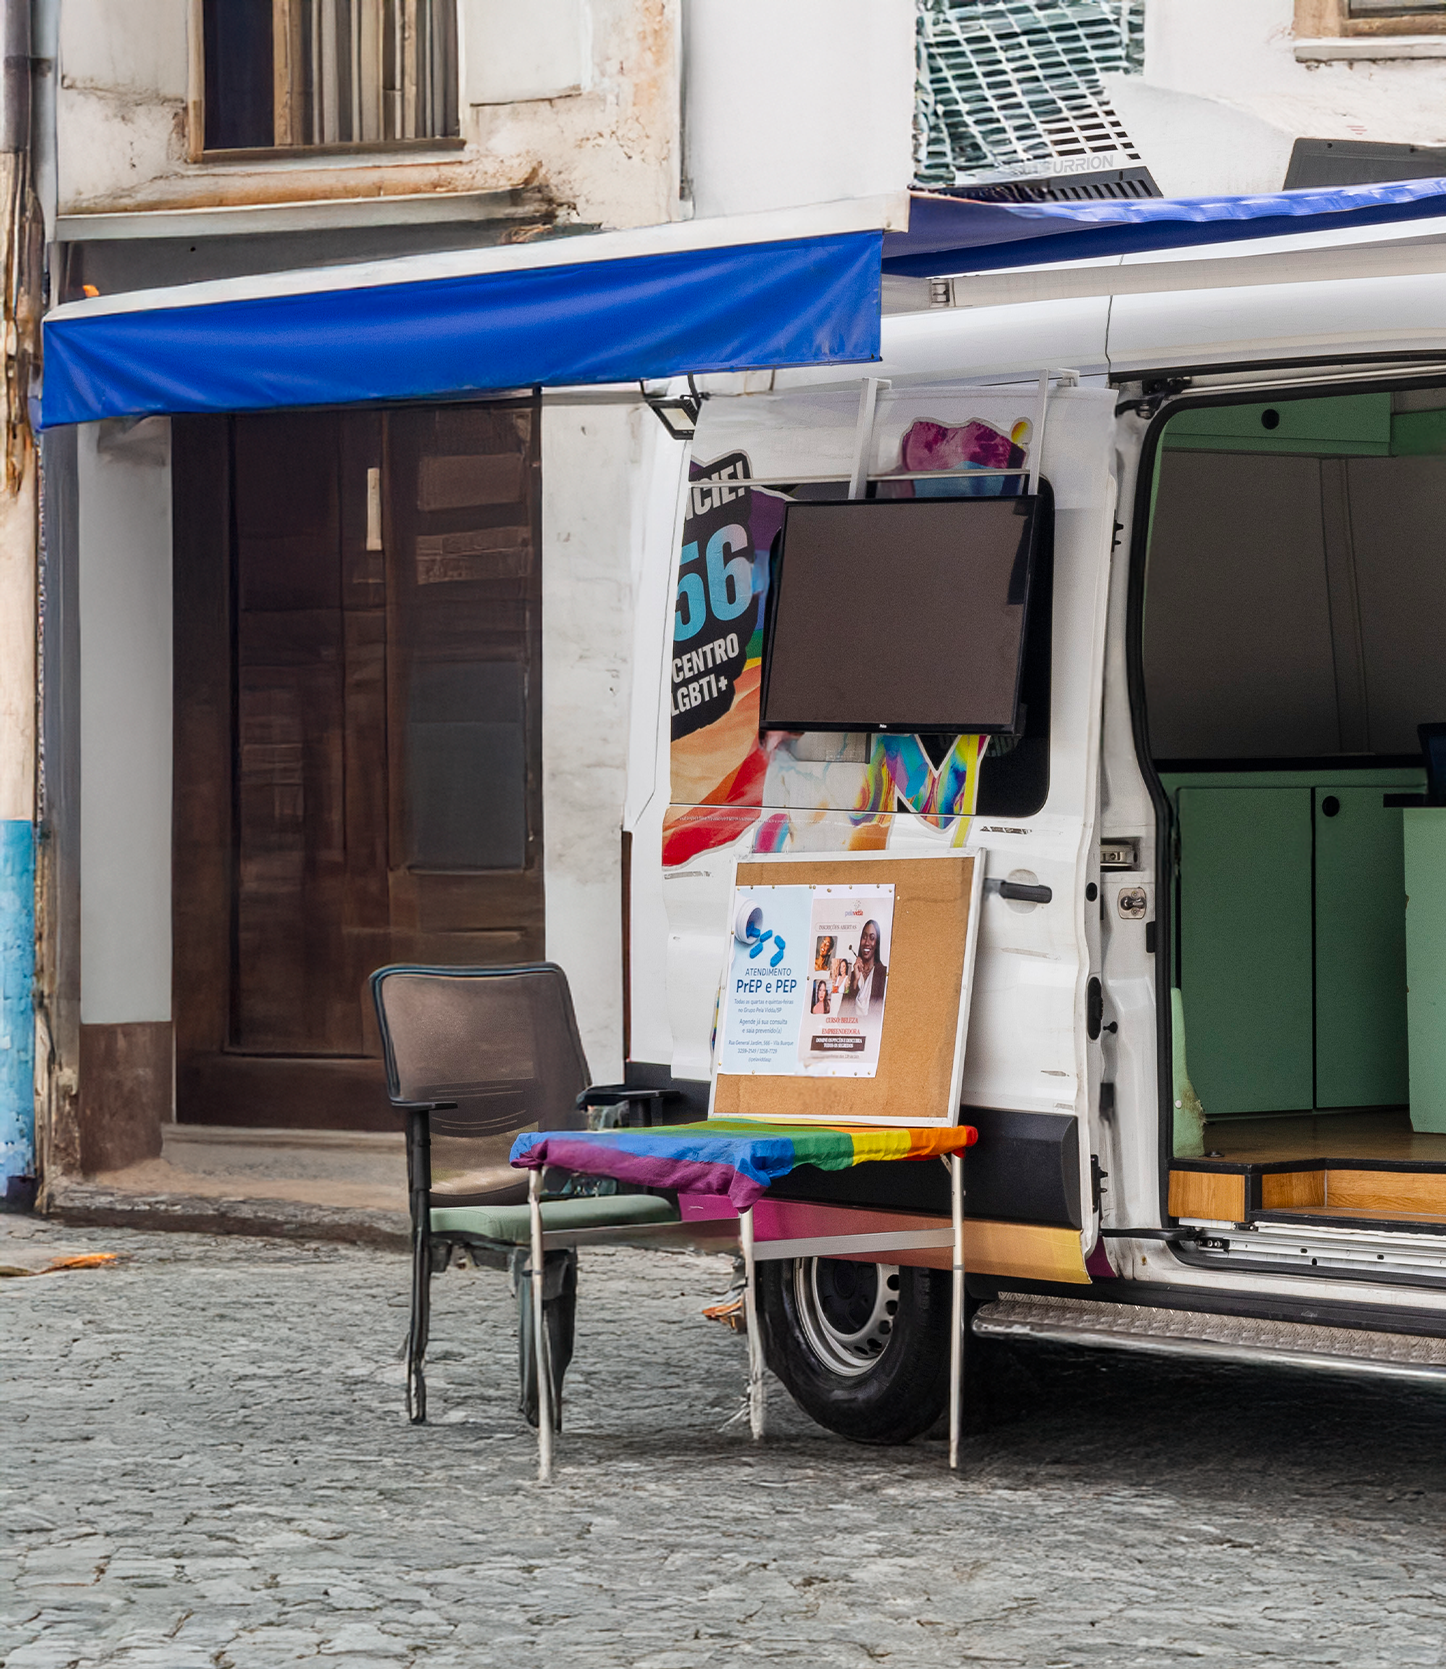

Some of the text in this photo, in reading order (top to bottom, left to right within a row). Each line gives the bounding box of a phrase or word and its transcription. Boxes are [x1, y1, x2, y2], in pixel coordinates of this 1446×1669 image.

[673, 524, 749, 641] 56
[672, 633, 739, 683] CENTRO
[671, 674, 728, 716] LGBTI+
[736, 979, 797, 993] PrEP e PEP
[745, 968, 792, 977] ATENDIMENTO
[739, 1018, 756, 1026] Agende
[756, 1018, 761, 1026] já
